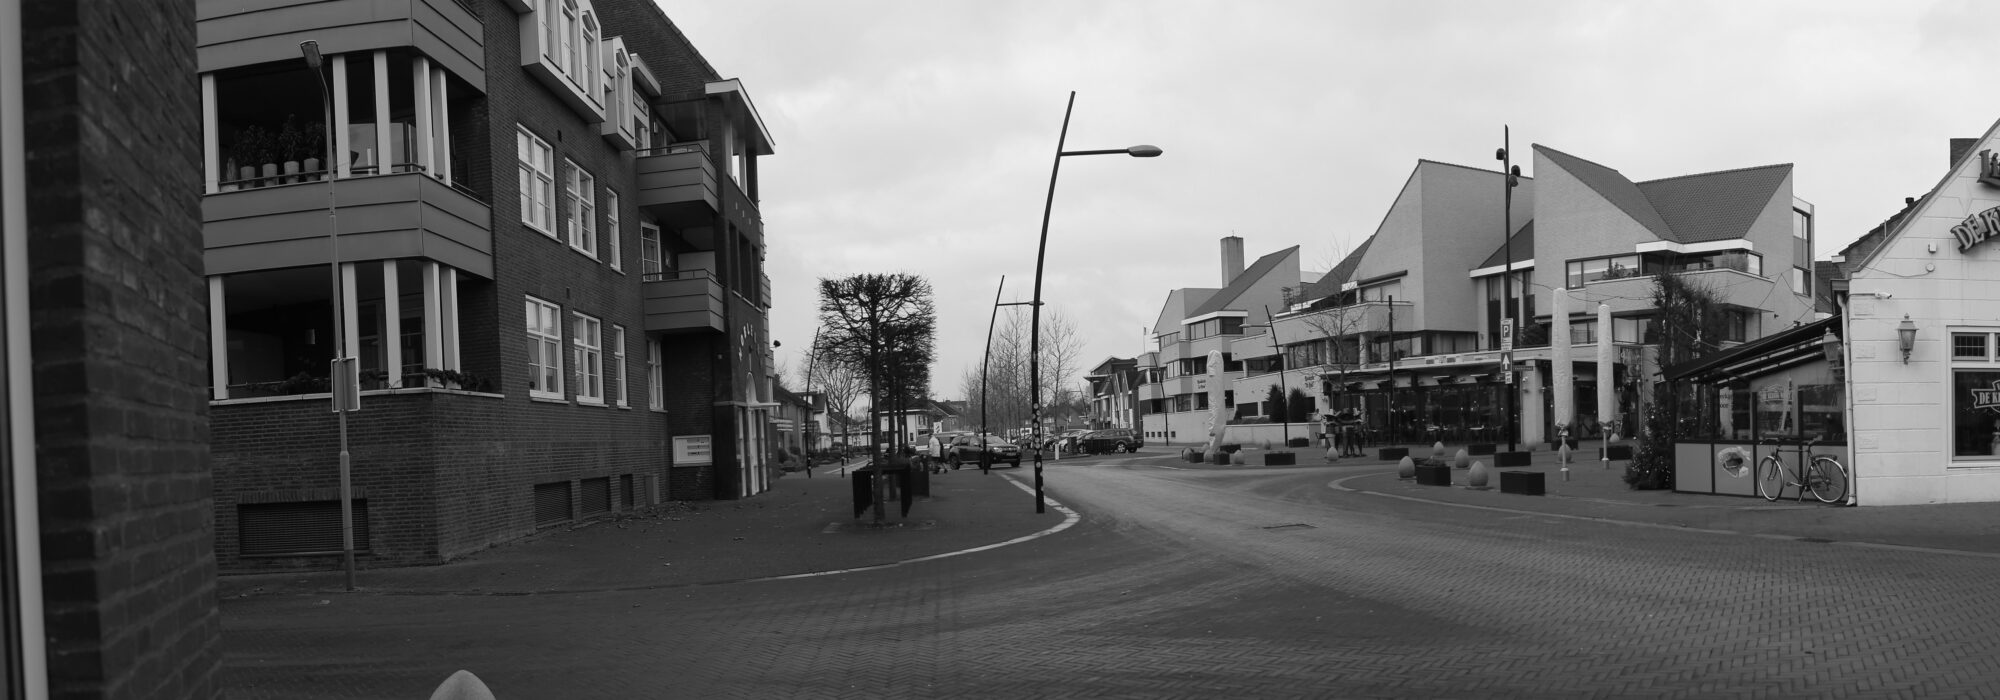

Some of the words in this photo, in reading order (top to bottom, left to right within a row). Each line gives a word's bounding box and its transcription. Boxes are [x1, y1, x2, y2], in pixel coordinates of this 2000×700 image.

[1976, 149, 2000, 189] Li
[1950, 213, 1985, 254] DE
[1504, 326, 1509, 337] P
[1979, 392, 1990, 404] DE
